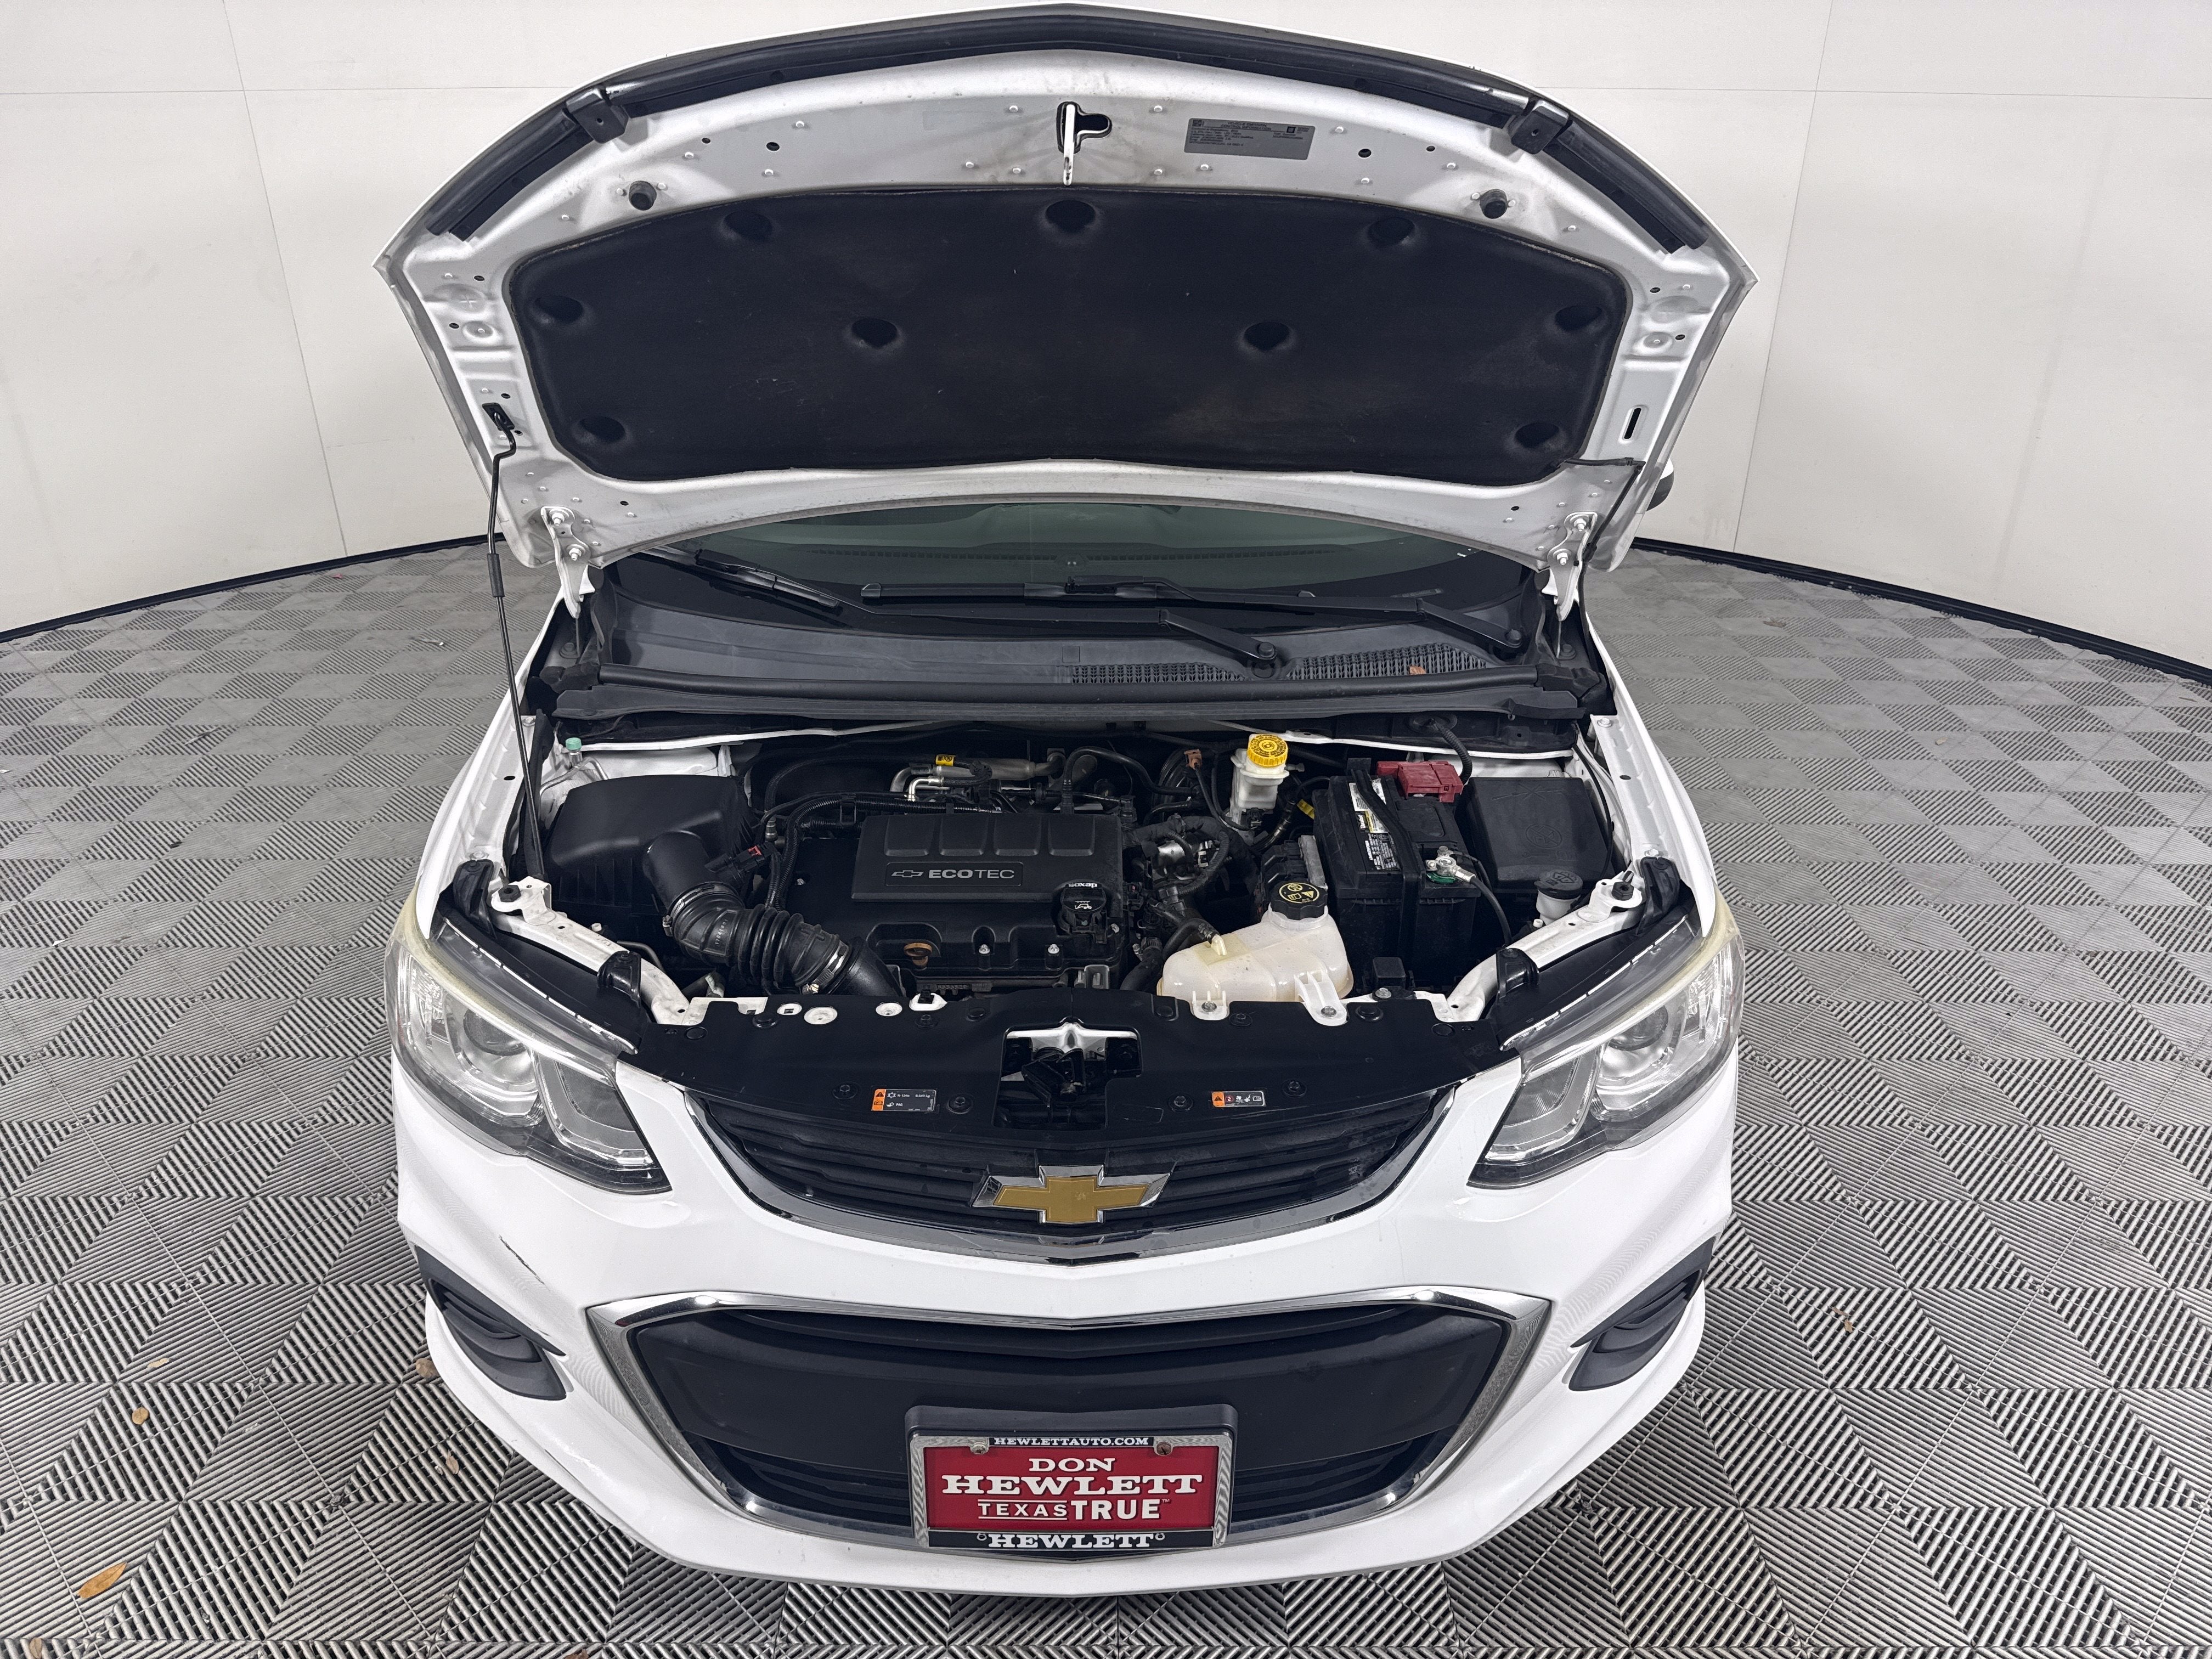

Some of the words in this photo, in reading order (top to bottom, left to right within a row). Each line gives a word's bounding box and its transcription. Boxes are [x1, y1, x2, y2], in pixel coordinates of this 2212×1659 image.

[928, 869, 1014, 879] ECOTEC
[994, 1437, 1149, 1446] HEWLETTAUTO.COM
[1029, 1458, 1116, 1472] DON
[941, 1475, 1203, 1496] HEWLETT
[988, 1533, 1155, 1549] HEWLETT
